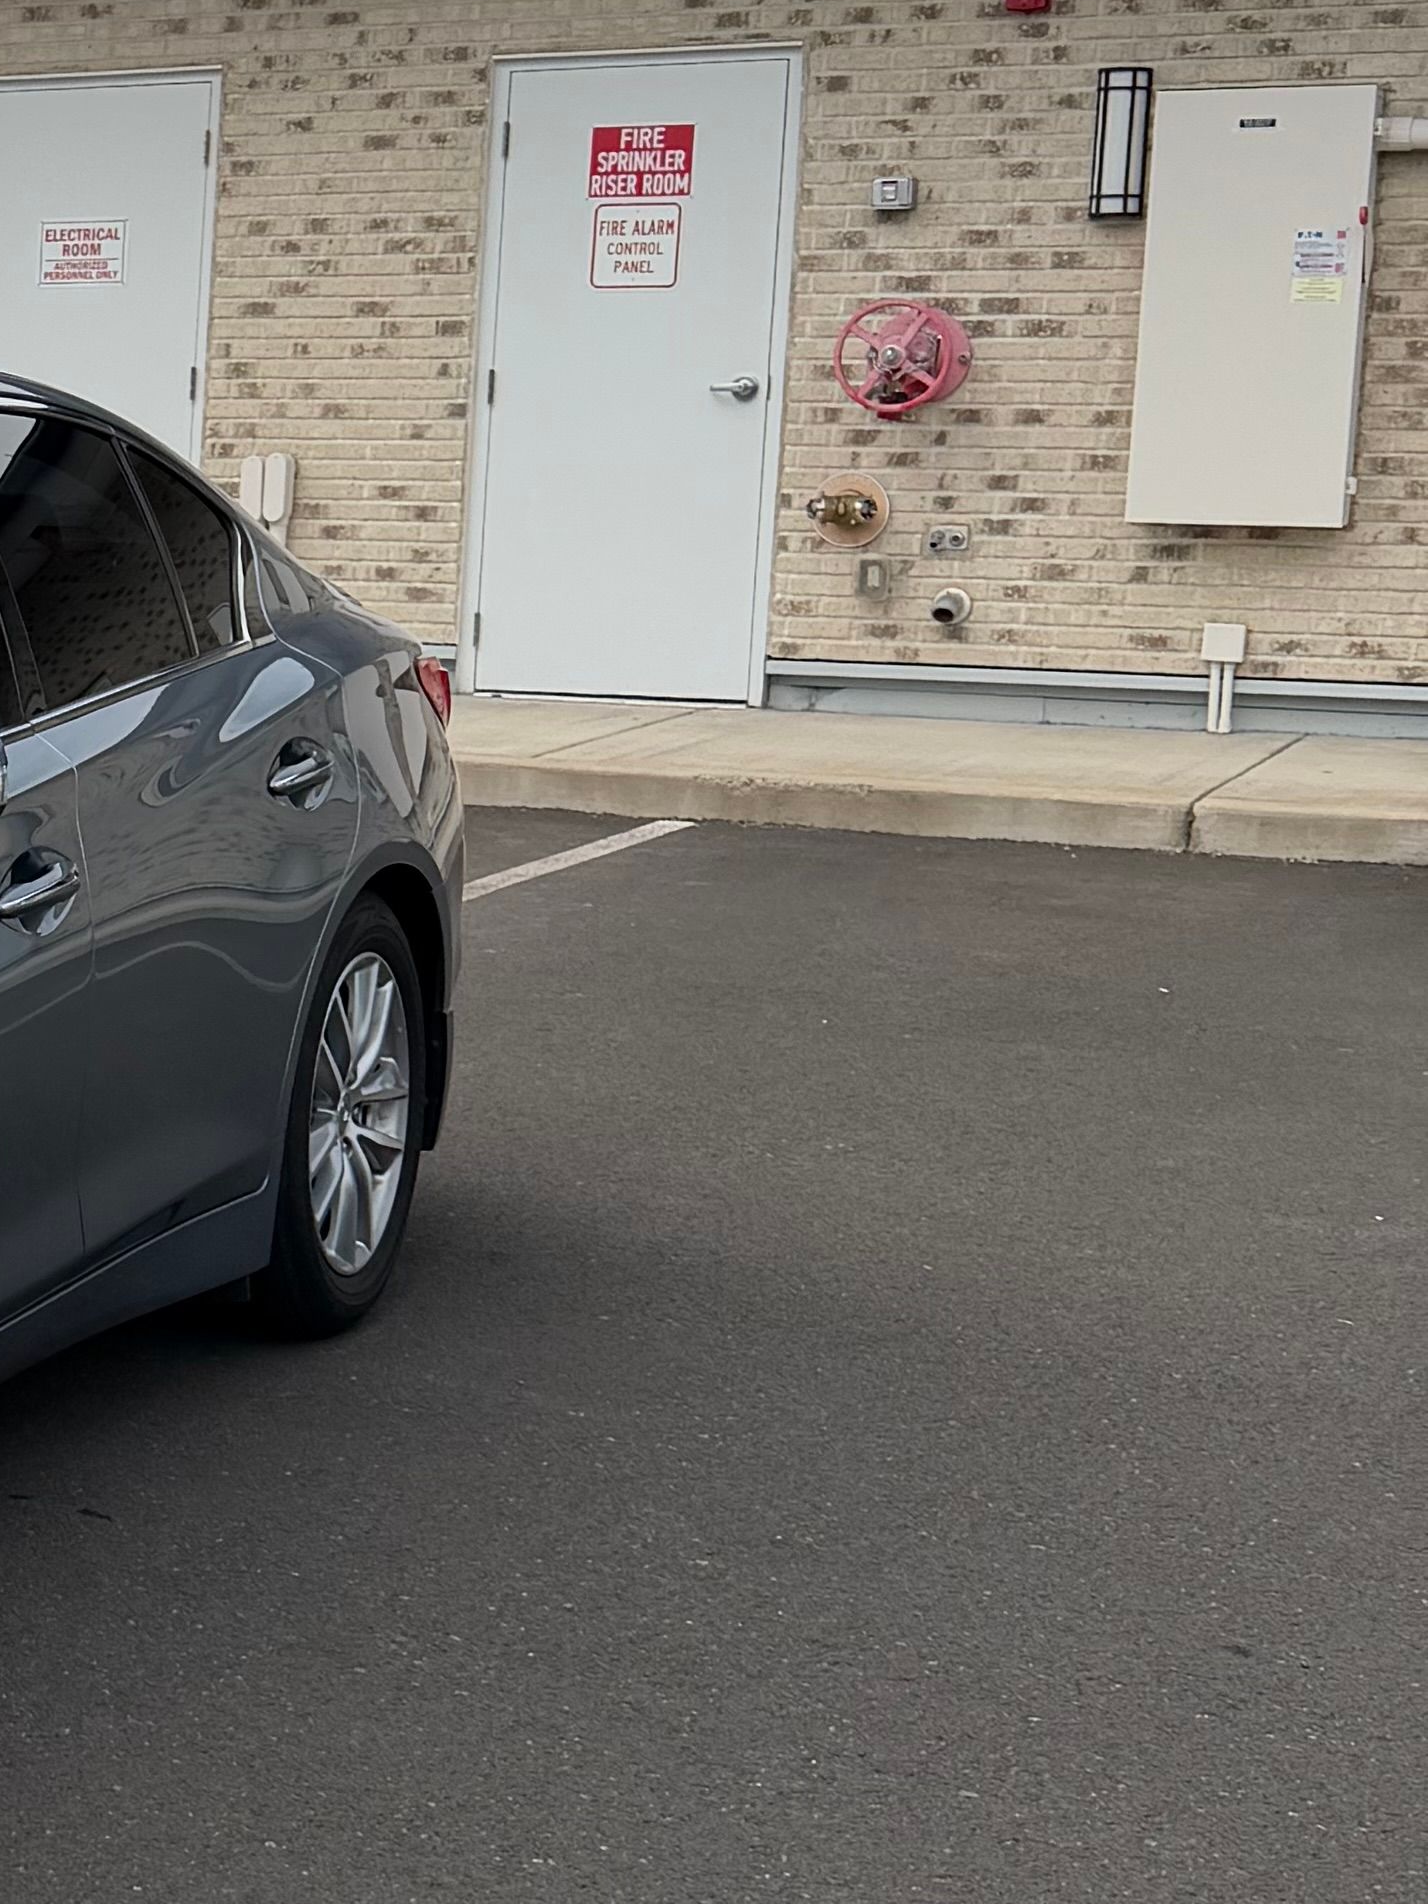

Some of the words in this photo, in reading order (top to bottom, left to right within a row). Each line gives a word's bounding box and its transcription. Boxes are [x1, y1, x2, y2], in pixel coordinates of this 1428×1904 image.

[619, 127, 666, 149] FIRE
[596, 149, 685, 173] SPRINKLER
[590, 174, 637, 196] RISER
[642, 172, 689, 194] ROOM
[45, 228, 120, 242] ELECTRICAL
[599, 220, 627, 237] FIRE
[632, 219, 675, 236] ALARM
[62, 243, 101, 257] ROOM
[607, 242, 663, 256] CONTROL
[54, 261, 108, 270] AUTHORIZED
[613, 260, 654, 274] PANEL
[44, 271, 94, 280] PERSONNEL
[96, 270, 119, 280] ONLY
